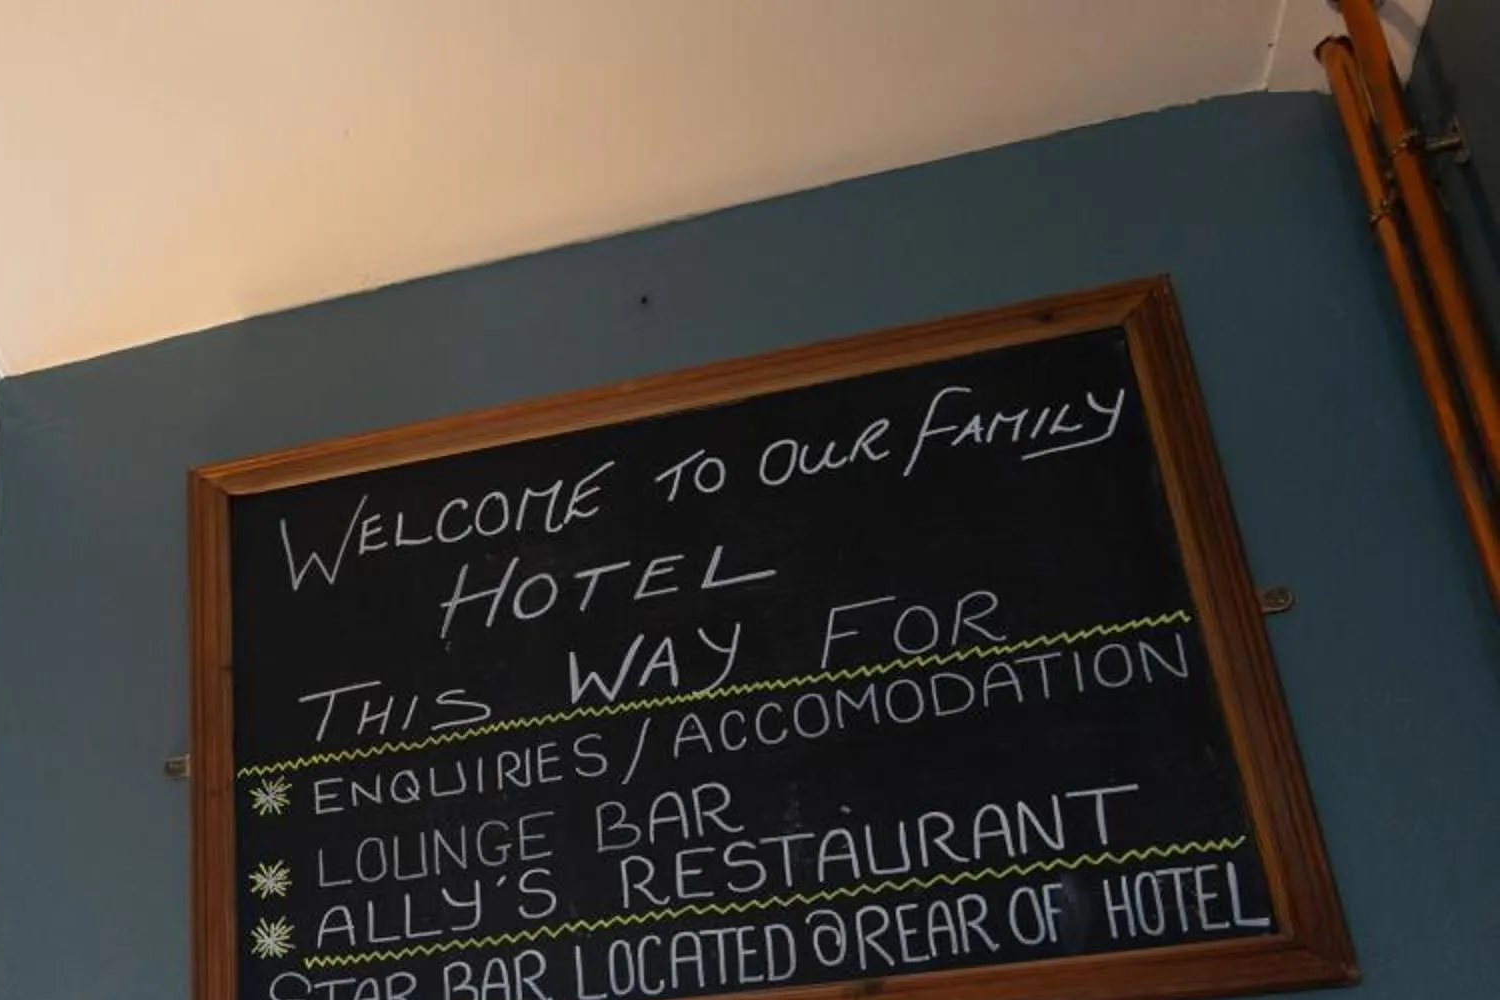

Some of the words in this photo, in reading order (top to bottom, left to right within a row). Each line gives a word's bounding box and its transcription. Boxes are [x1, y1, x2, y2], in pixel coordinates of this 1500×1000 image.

[280, 461, 616, 592] WELCOME
[654, 449, 727, 502] TO
[759, 418, 890, 486] OUR
[903, 386, 1126, 477] FAMILY
[439, 545, 777, 639] HOTEL
[298, 681, 492, 742] THIS
[569, 622, 741, 703] WAY
[820, 590, 1007, 669] FOR
[316, 867, 558, 949] ALLY'S
[621, 783, 1140, 909] RESTAURANT
[317, 811, 556, 888] LOUNGE
[596, 782, 744, 853] BAR
[574, 923, 797, 1000] LOCATED
[1008, 882, 1064, 945] OF
[1103, 861, 1271, 939] HOTEL
